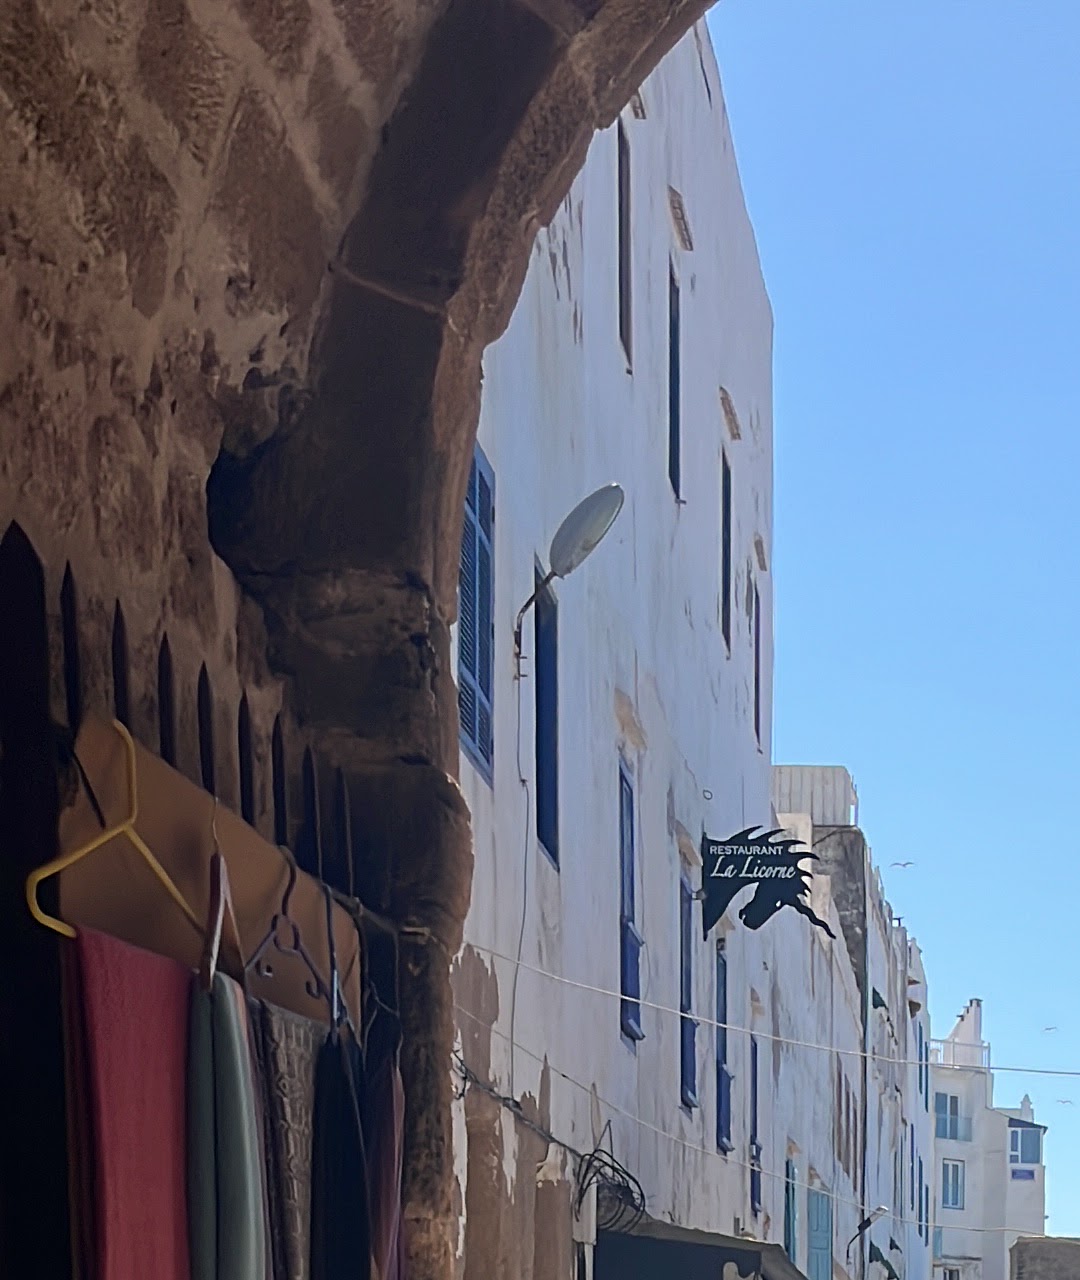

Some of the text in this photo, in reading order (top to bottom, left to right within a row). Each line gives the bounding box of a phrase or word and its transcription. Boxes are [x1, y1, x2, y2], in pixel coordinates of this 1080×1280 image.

[709, 845, 783, 855] RESTAURANT
[710, 855, 796, 878] La Licorne
